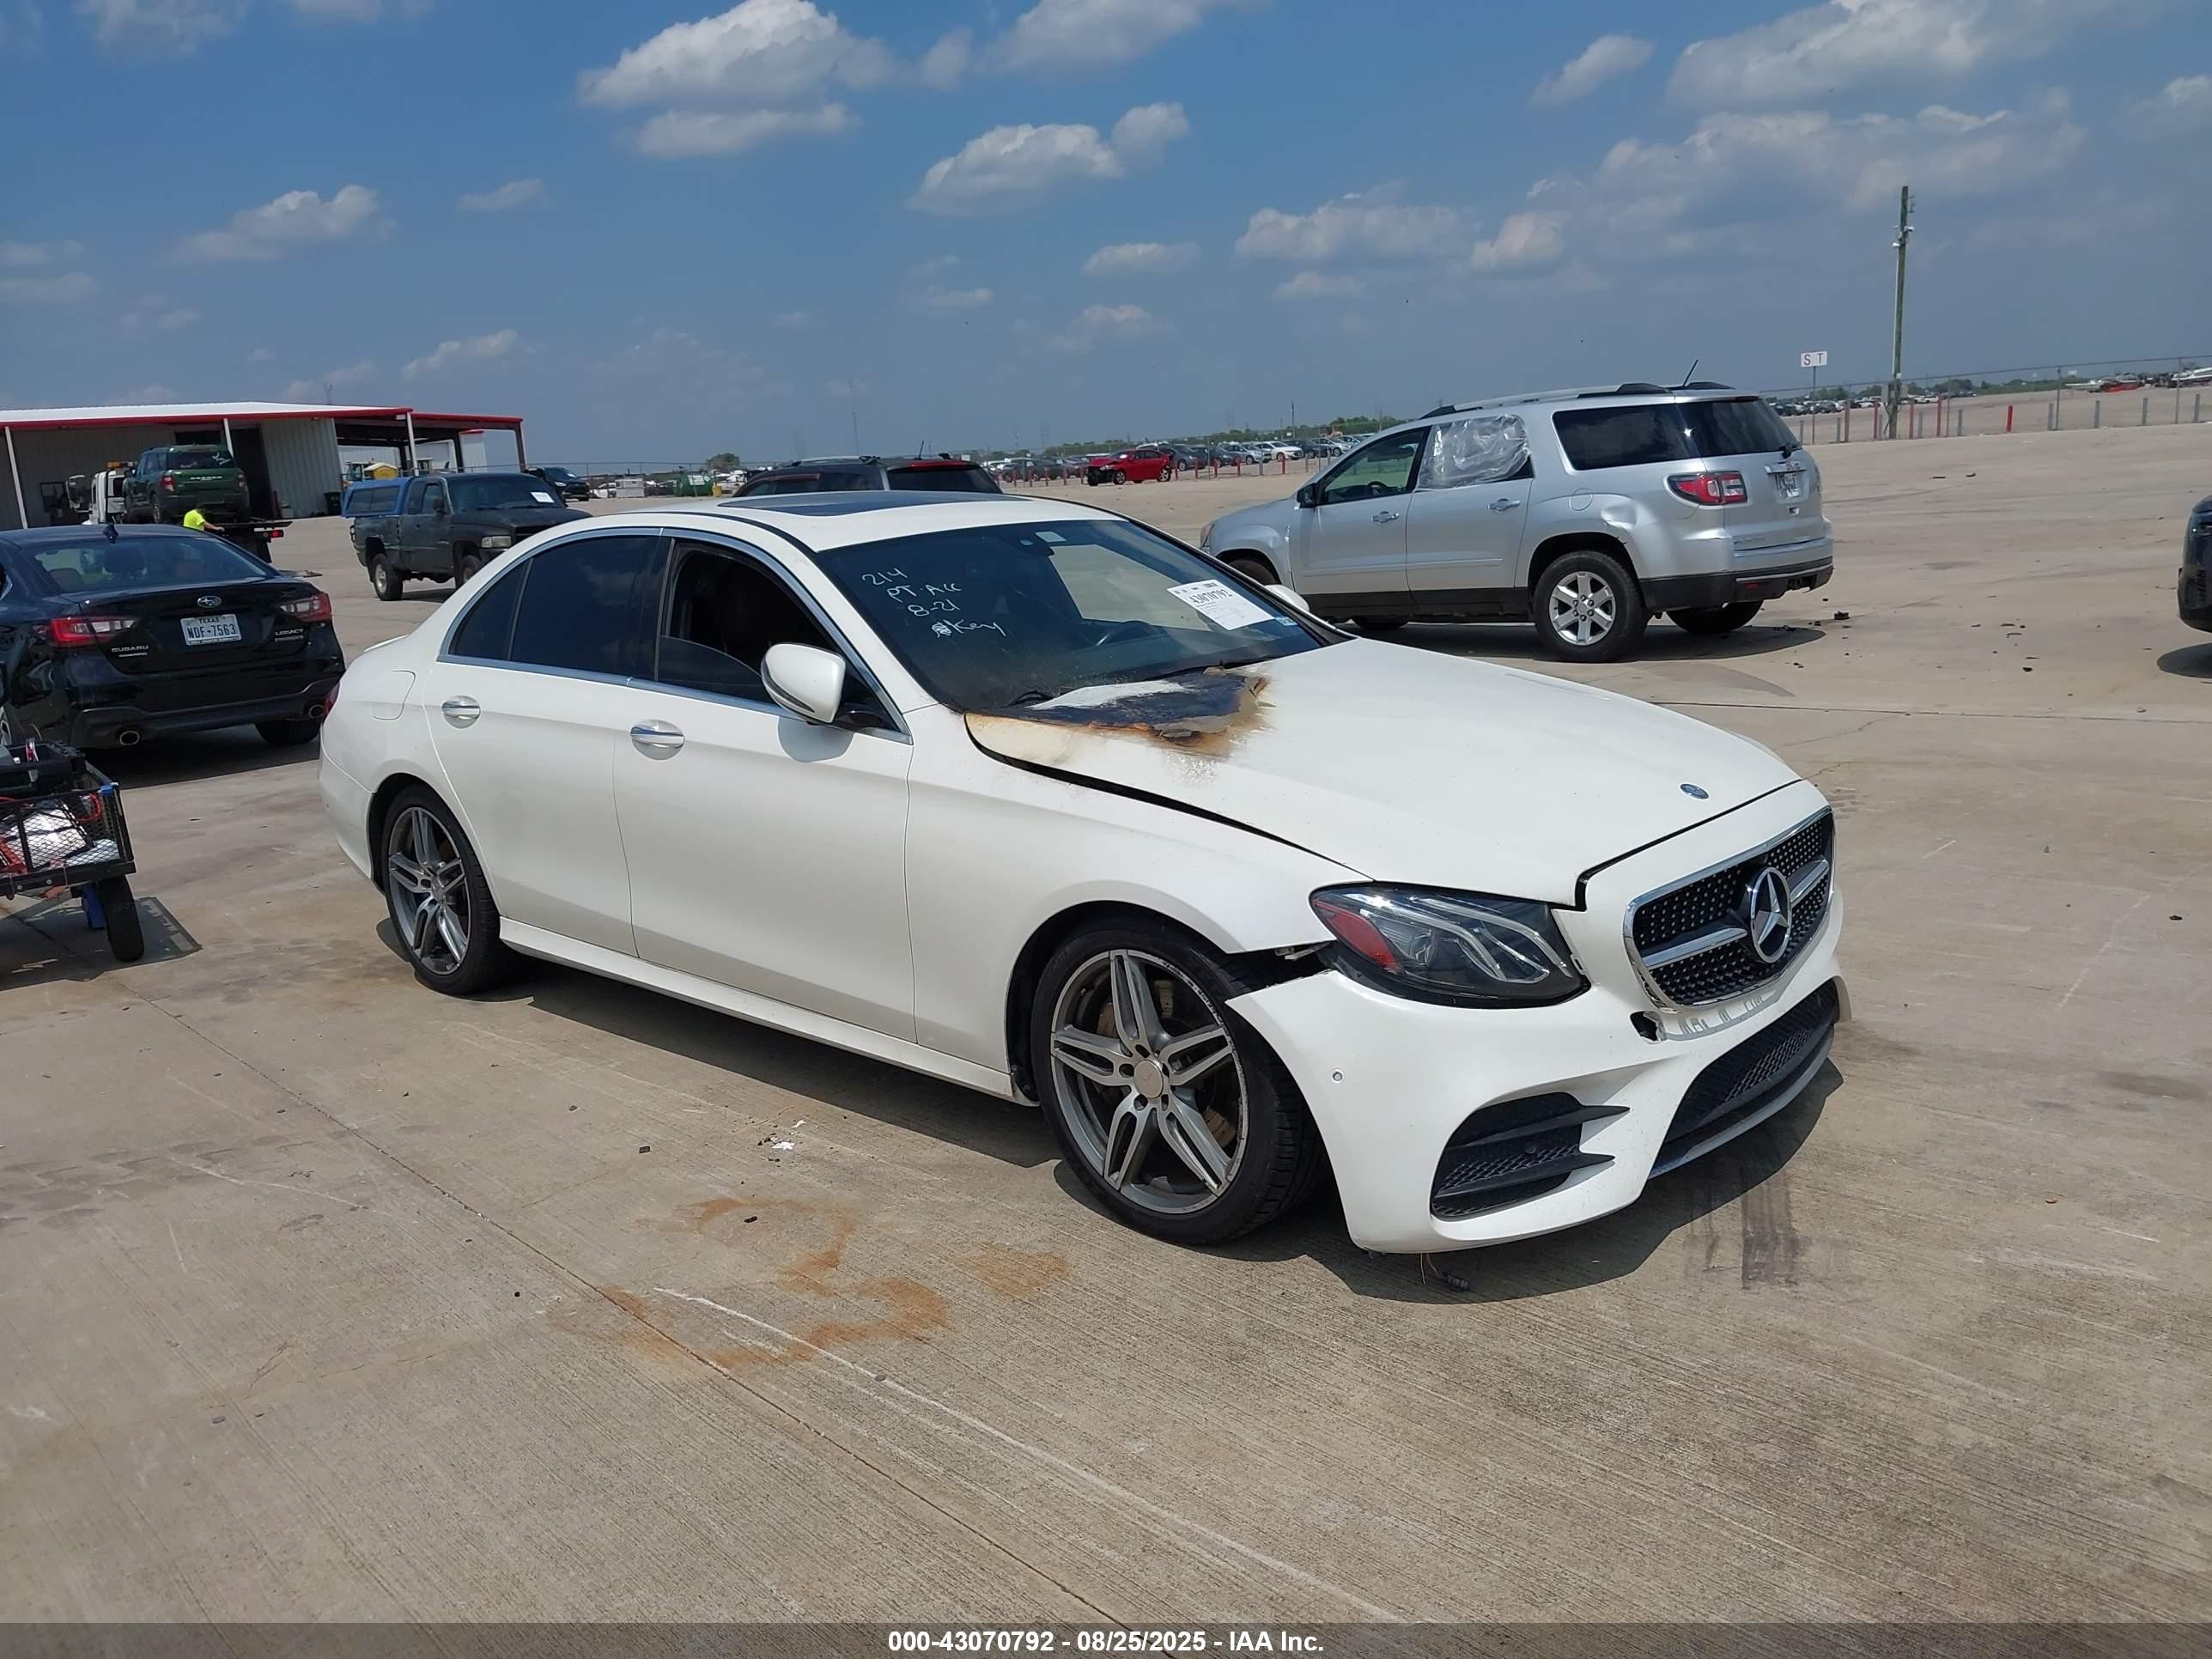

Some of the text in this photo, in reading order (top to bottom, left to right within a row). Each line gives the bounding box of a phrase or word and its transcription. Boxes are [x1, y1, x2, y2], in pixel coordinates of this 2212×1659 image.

[1803, 353, 1824, 366] S T
[861, 568, 908, 586] 214
[907, 599, 962, 617] 8-21
